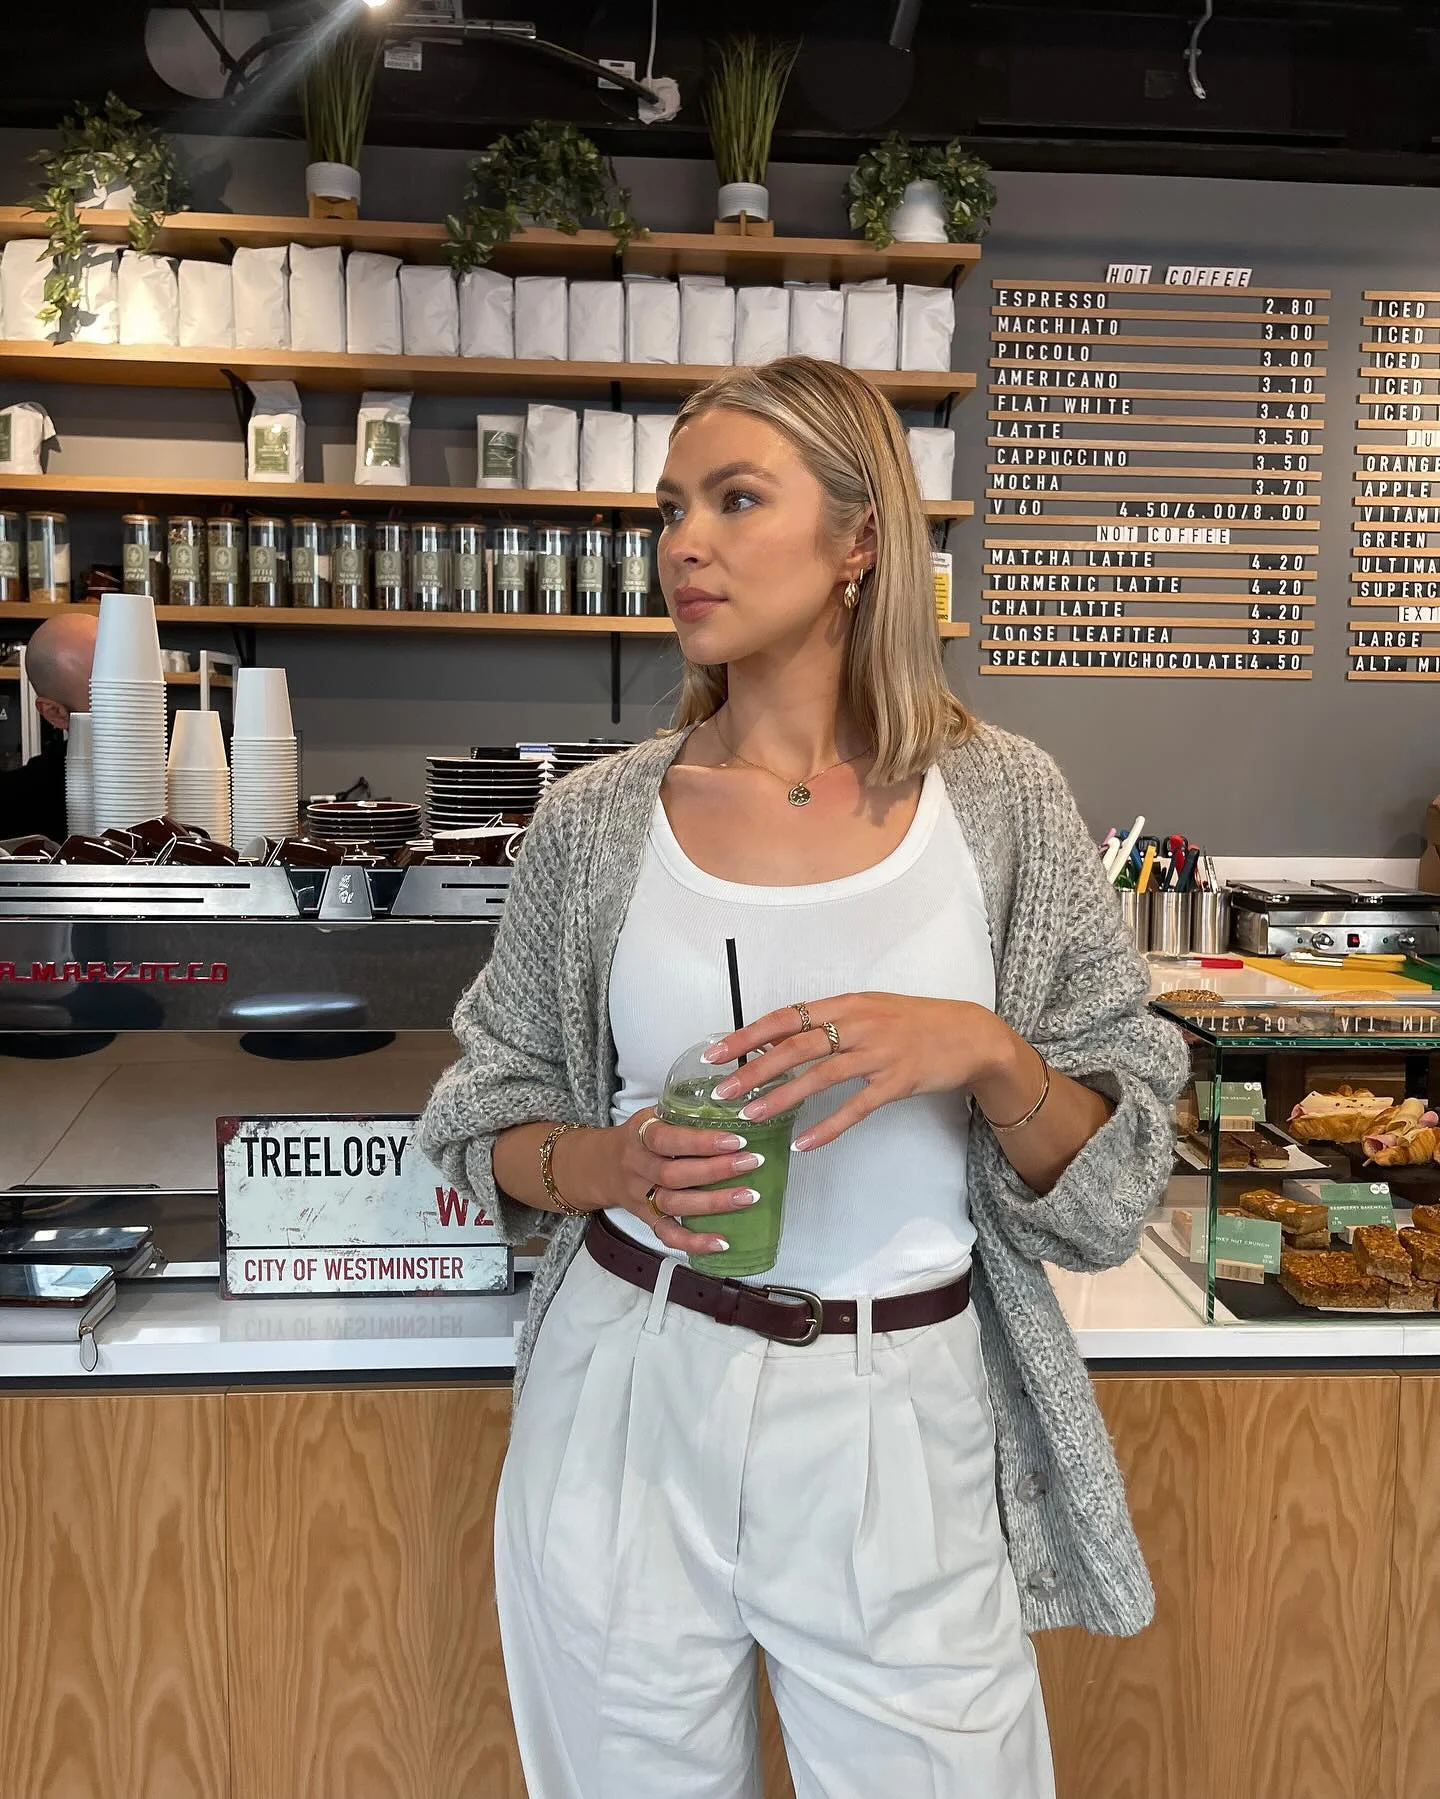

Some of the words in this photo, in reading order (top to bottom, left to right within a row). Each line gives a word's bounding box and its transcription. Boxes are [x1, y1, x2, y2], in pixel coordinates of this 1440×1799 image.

[1110, 268, 1149, 284] HOT
[1168, 270, 1249, 287] COFFEE
[999, 291, 1106, 309] ESPRESSO
[1266, 299, 1314, 316] 2.80
[1378, 301, 1425, 318] ICED
[998, 317, 1119, 335] MACCHIATO
[1264, 325, 1313, 341] 3.00
[1377, 327, 1424, 344] ICED
[999, 344, 1090, 361] PICCOLO
[1263, 352, 1313, 368] 3.00
[1376, 353, 1420, 369] ICED
[998, 371, 1118, 389] AMERICANO
[1262, 377, 1313, 394] 3.10
[1375, 379, 1422, 395] ICED
[997, 396, 1048, 413] FLAT
[1064, 398, 1131, 415] WHITE
[1260, 404, 1309, 420] 3.40
[1374, 405, 1421, 421] ICED
[996, 422, 1062, 439] LATTE
[1258, 429, 1309, 445] 3.50
[1411, 432, 1432, 446] JU
[997, 449, 1127, 466] CAPPUCCINO
[1256, 455, 1308, 471] 3.50
[994, 475, 1059, 491] MOCHA
[1255, 480, 1305, 496] 3.70
[1364, 482, 1429, 498] APPLE
[994, 500, 1001, 515] V
[1019, 500, 1041, 515] 60
[1364, 507, 1439, 523] VITAMI
[1100, 527, 1136, 541] NOT
[1151, 528, 1228, 544] COFFEE
[1363, 532, 1425, 548] GREEN
[991, 550, 1071, 565] MATCHA
[1089, 552, 1153, 567] LATTE
[1251, 555, 1303, 570] 4.20
[1362, 558, 1436, 574] ULTIMA
[992, 575, 1096, 592] TURMERIC
[1116, 577, 1179, 593] LATTE
[1251, 579, 1302, 595] 4.20
[1361, 582, 1437, 598] SUPERC
[991, 600, 1042, 616] CHAI
[1060, 602, 1123, 617] LATTE
[1251, 604, 1300, 620] 4.20
[1403, 608, 1433, 621] EXT
[1251, 629, 1299, 645] 3.50
[1358, 632, 1419, 647] LARGE
[1355, 657, 1401, 671] ALT.
[240, 1136, 408, 1178] TREELOGY
[244, 1258, 286, 1281] CITY
[294, 1258, 317, 1280] OF
[324, 1257, 464, 1280] WESTMINSTER
